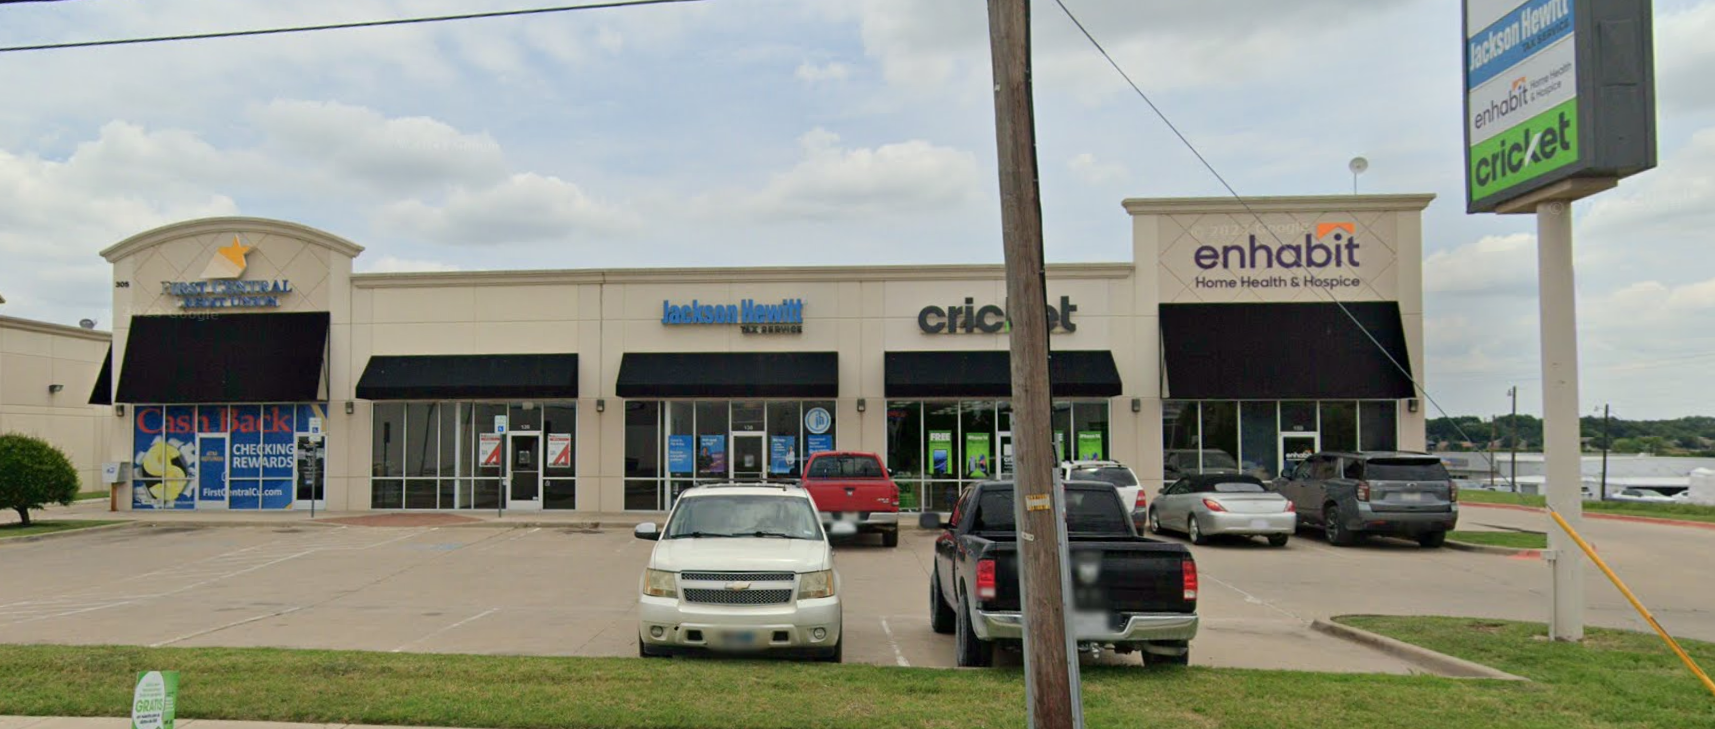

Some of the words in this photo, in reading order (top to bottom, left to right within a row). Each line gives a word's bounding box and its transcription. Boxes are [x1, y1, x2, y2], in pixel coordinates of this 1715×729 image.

[1470, 21, 1520, 71] Jackson
[1521, 0, 1569, 40] Hewitt
[1522, 39, 1537, 52] TAX
[1538, 18, 1571, 44] SERVICE
[1530, 75, 1549, 89] Home
[1550, 62, 1572, 79] Health
[1536, 80, 1562, 97] Hospice
[1474, 85, 1529, 129] enhabit
[1475, 112, 1571, 187] cricket
[1194, 233, 1360, 269] enhabit
[160, 281, 207, 295] FIRST
[211, 279, 293, 294] CENTRAL
[1195, 276, 1237, 288] Home
[1240, 275, 1287, 288] Health
[1290, 276, 1300, 288] &
[1303, 275, 1360, 290] Hospice
[661, 300, 738, 324] Jackson
[740, 299, 803, 324] Hewitt
[918, 295, 1077, 334] crict
[740, 325, 759, 334] TAX
[761, 325, 803, 334] SERVICE
[137, 407, 211, 433] Cash
[218, 406, 292, 433] Back
[931, 432, 952, 441] FREE
[232, 443, 294, 455] CHECKING
[1285, 451, 1312, 459] enhab
[232, 456, 294, 468] REWARDS
[203, 487, 282, 498] FirstCntralCu.com
[136, 699, 163, 712] GRATIS
